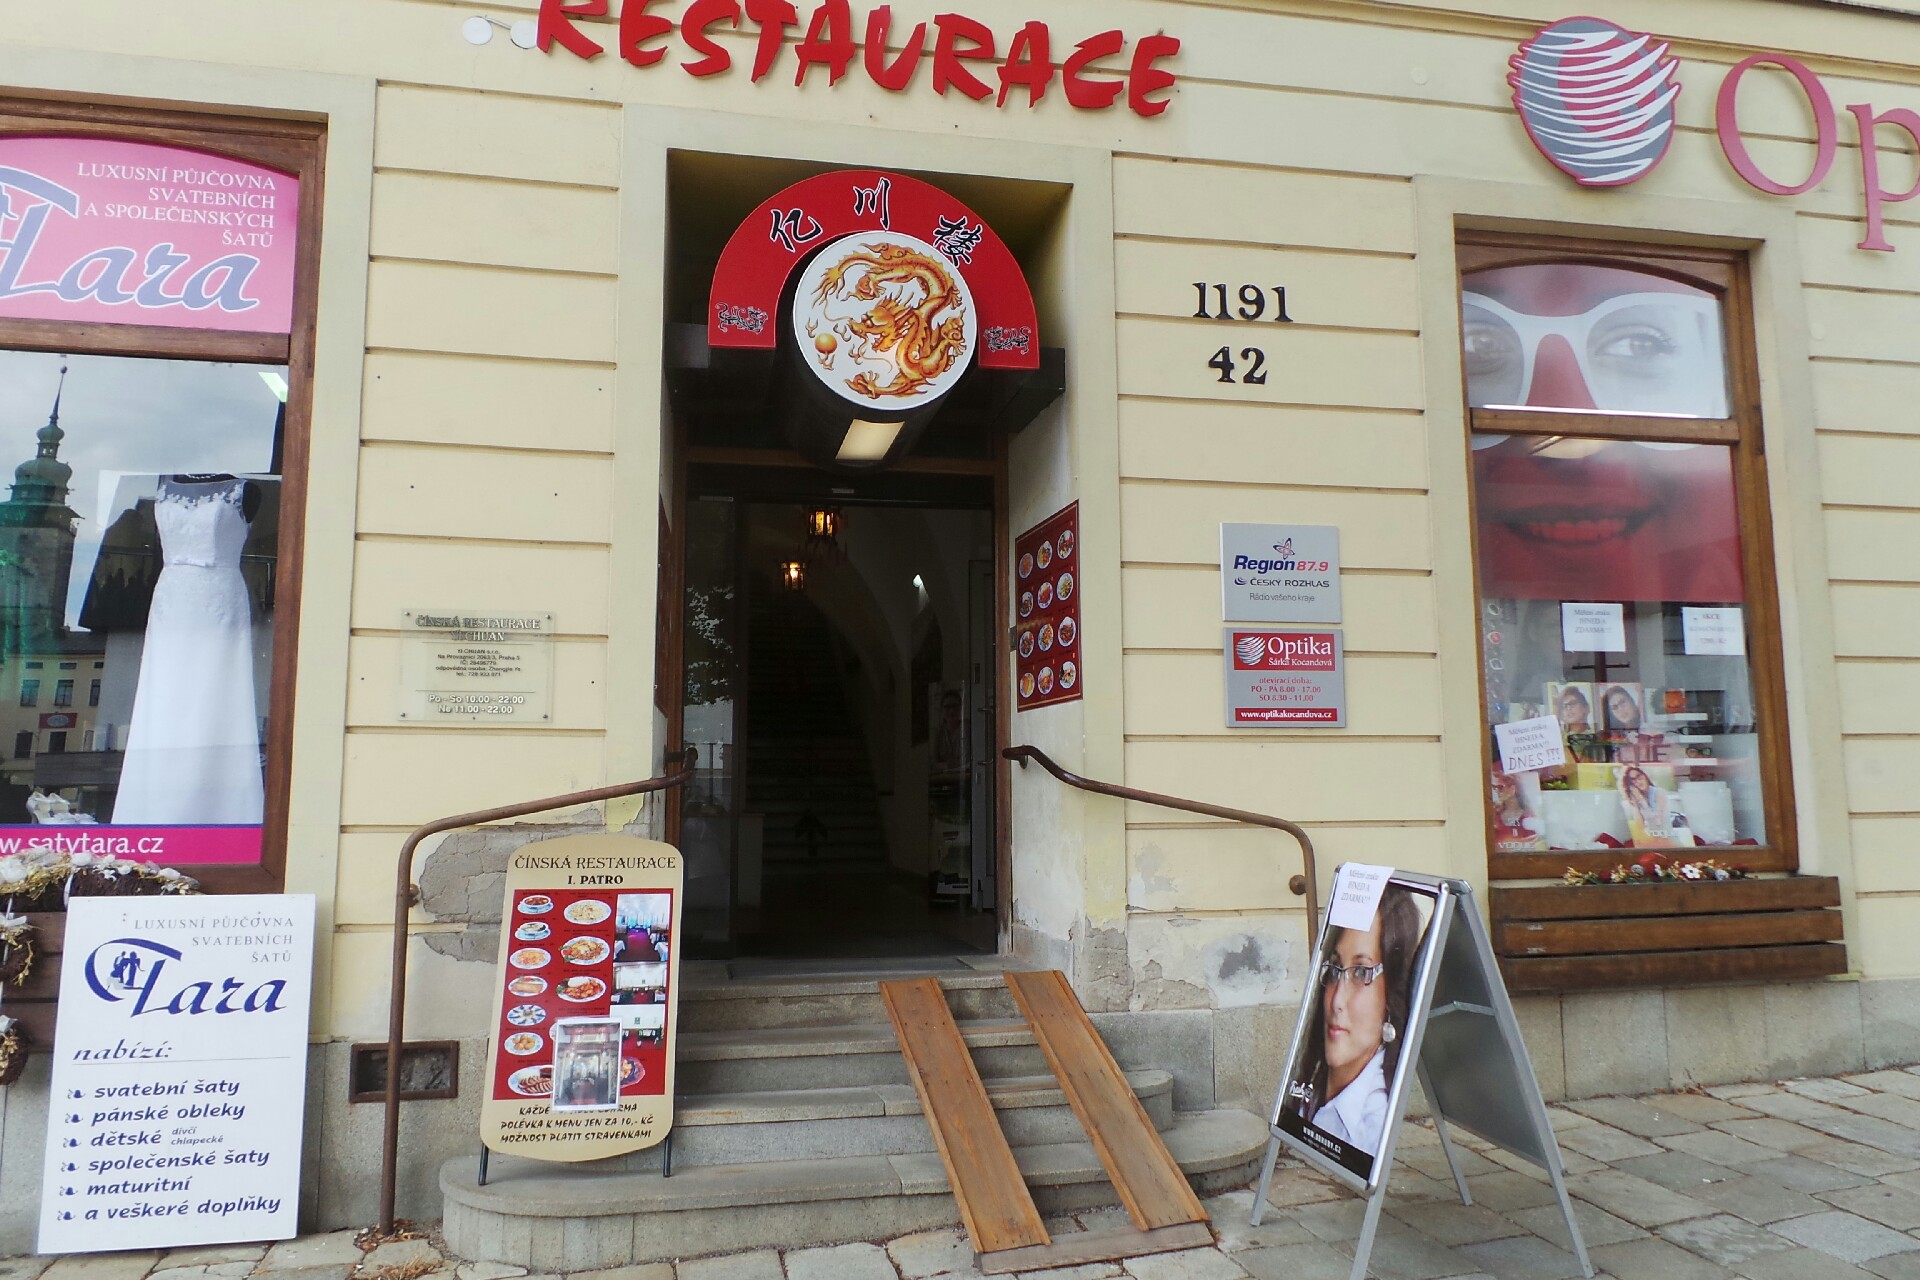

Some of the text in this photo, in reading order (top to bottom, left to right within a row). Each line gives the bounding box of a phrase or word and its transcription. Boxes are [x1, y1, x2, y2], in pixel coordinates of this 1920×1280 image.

[537, 0, 1181, 116] RESTAURACE
[78, 163, 276, 190] LUXUSNÍ PŮJČOVNA
[149, 188, 274, 208] SVATEBNÍCH
[84, 203, 274, 228] A SPOLEČENSKÝCH
[222, 230, 273, 247] ŠATŮ
[1192, 282, 1294, 322] 1191
[1208, 346, 1268, 385] 42
[1233, 555, 1329, 574] Region 87.9
[1250, 577, 1281, 586] ČESKÝ
[1250, 592, 1270, 601] Rádio
[1298, 594, 1315, 603] kraje
[463, 618, 540, 629] RESTAURACE
[464, 632, 504, 641] CHUAN
[1268, 636, 1332, 660] Optika
[1268, 658, 1332, 666] Šárka Kocandová
[429, 694, 441, 703] Po
[449, 695, 462, 703] So
[466, 695, 490, 703] 10.00
[498, 696, 524, 704] 22.00
[454, 706, 479, 714] 11.00
[487, 706, 513, 714] 22.00
[1240, 710, 1332, 719] www.optikakocandova.cz
[514, 854, 676, 869] ČÍNSKÁ RESTAURACE
[568, 875, 624, 885] I. PATRO
[134, 916, 294, 929] LUXUSNÍ PŮJČOVNA
[192, 933, 293, 946] SVATEBNÍCH
[252, 950, 292, 963] ŠATŮ
[72, 1038, 172, 1060] nabízí:
[94, 1079, 240, 1098] svatební šaty
[91, 1103, 245, 1126] pánské obleky
[519, 1104, 550, 1116] KAŽDÉ
[501, 1118, 542, 1130] POLÉVKA
[546, 1120, 552, 1128] K
[555, 1119, 582, 1128] MENU
[584, 1118, 601, 1127] JEN
[605, 1118, 617, 1126] ZA
[641, 1114, 654, 1125] KČ
[91, 1129, 162, 1147] dětské
[172, 1126, 198, 1135] dívčí
[500, 1130, 652, 1143] MOŽNOST PLATIT STRAVENKAMI
[171, 1135, 224, 1146] chlapecké
[88, 1150, 270, 1175] společenské šaty
[87, 1176, 192, 1195] maturitní
[85, 1196, 281, 1220] a veškeré doplňky
